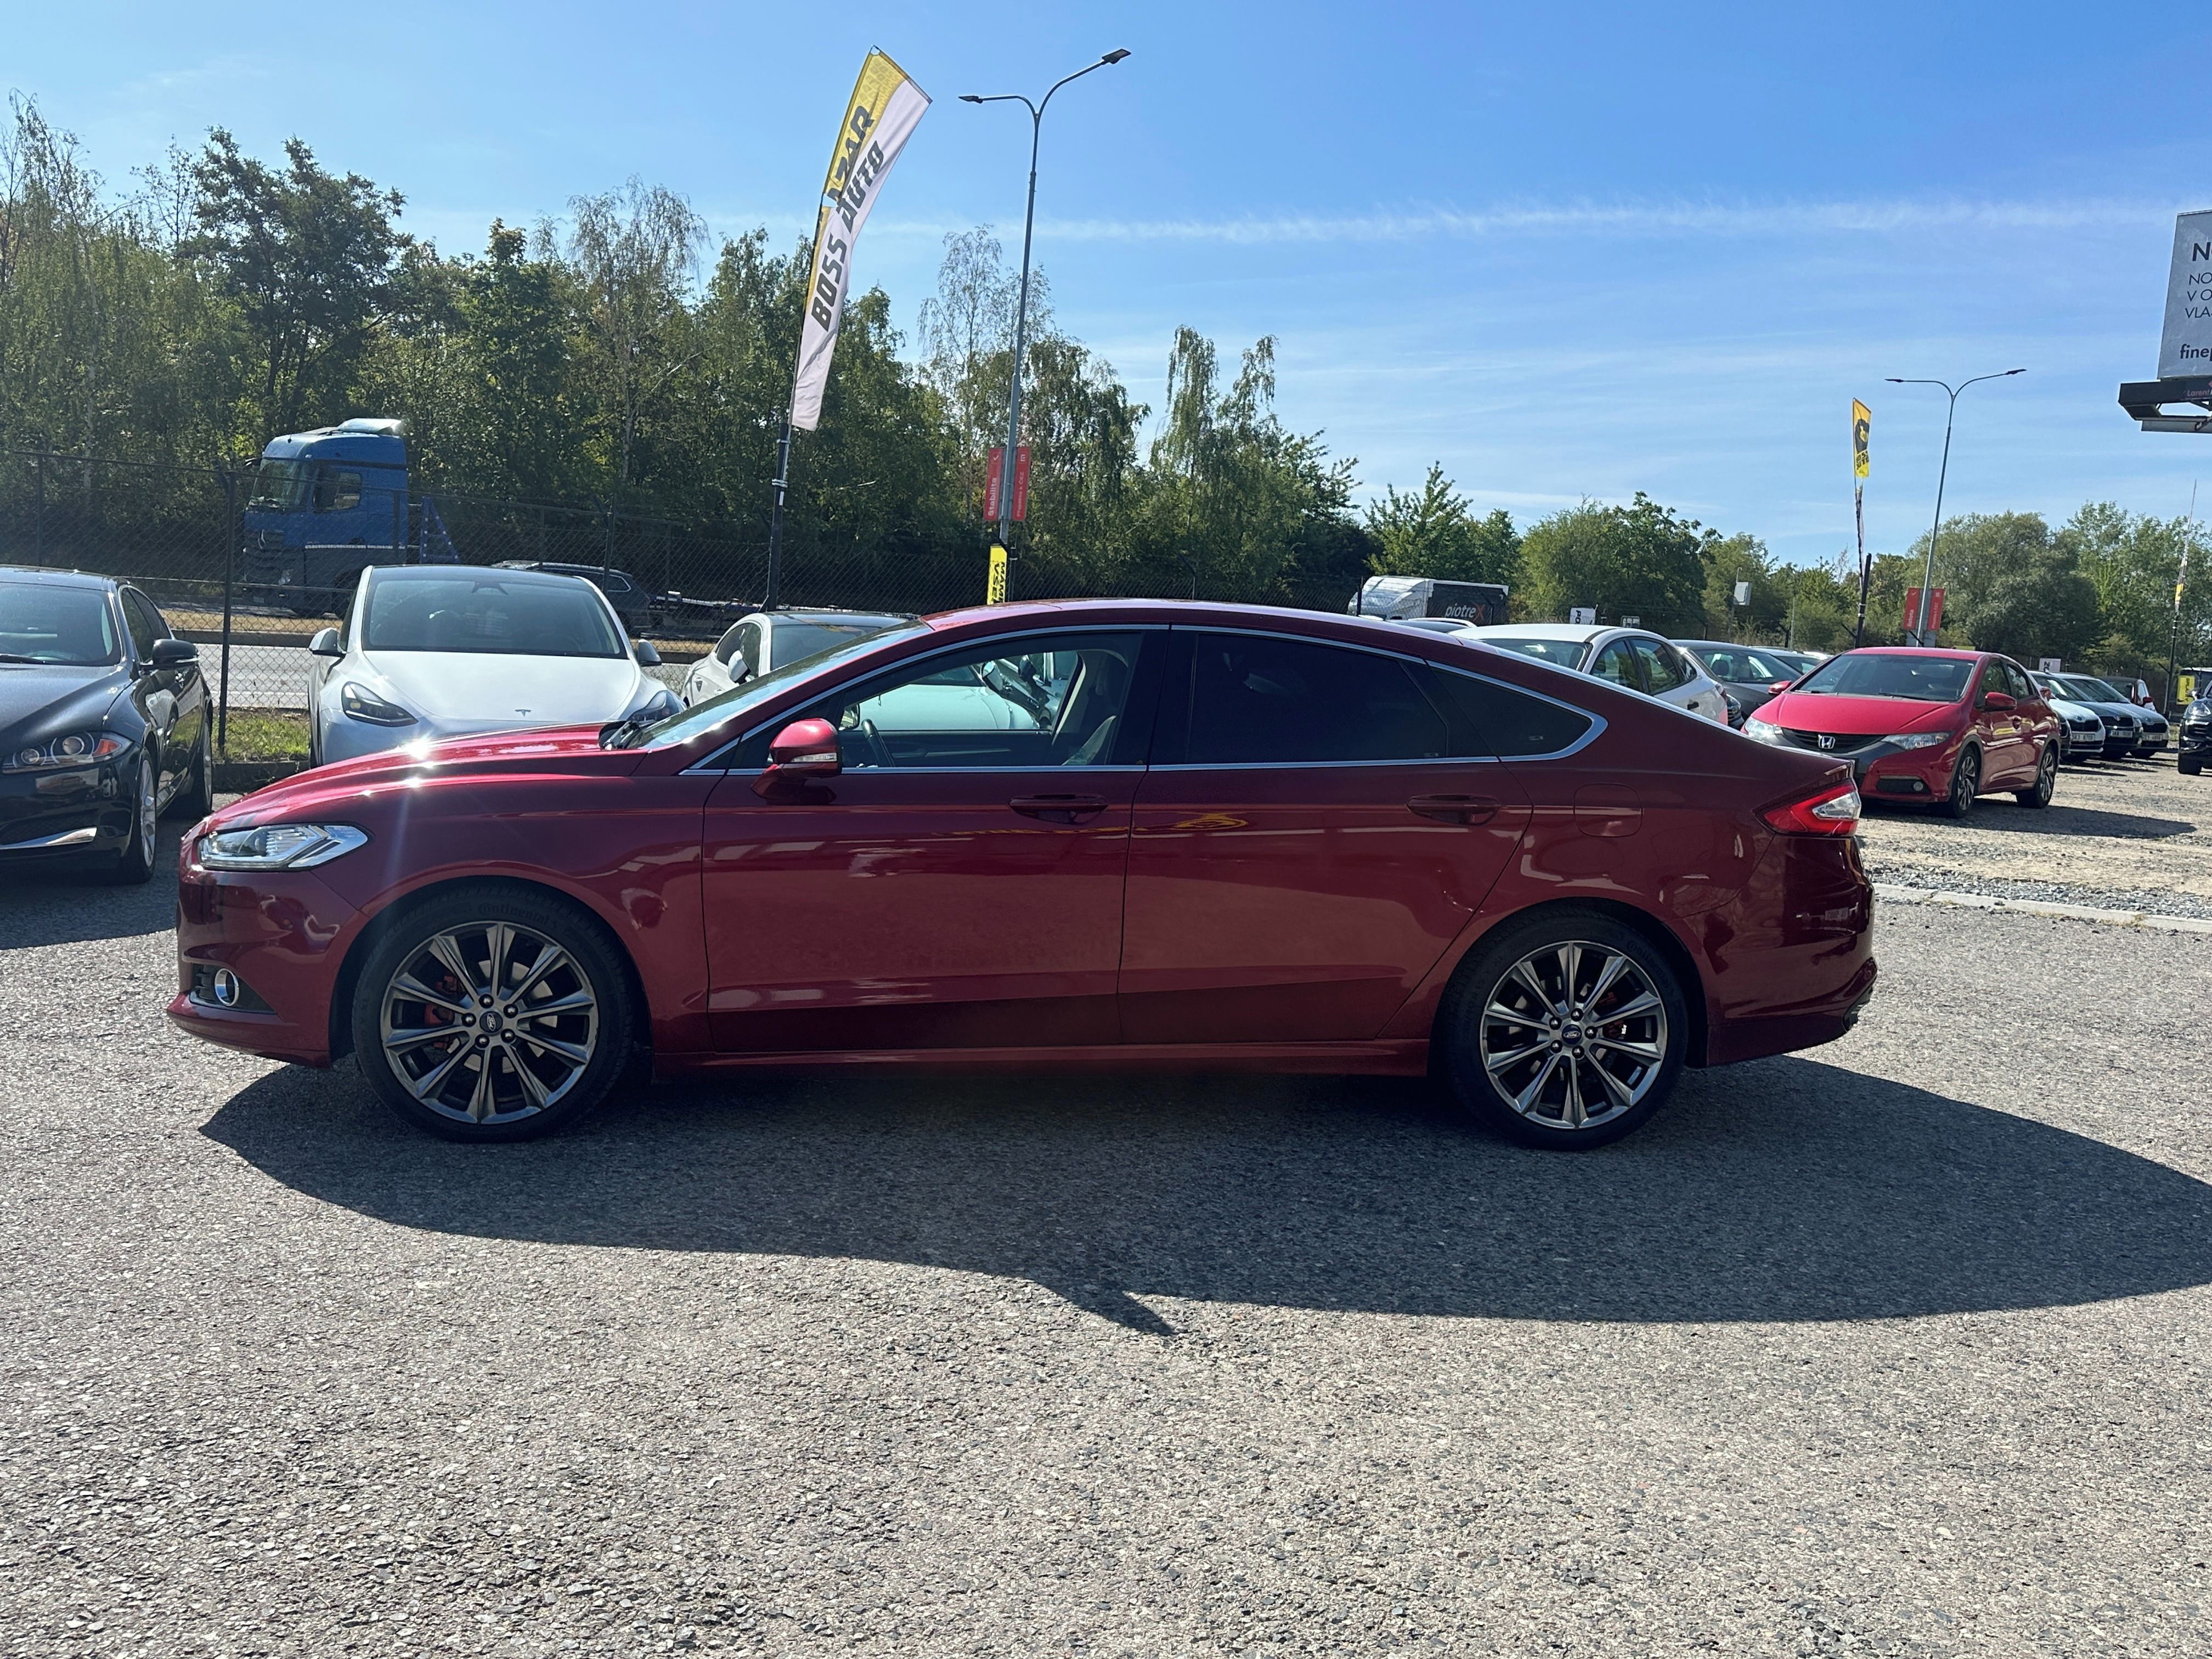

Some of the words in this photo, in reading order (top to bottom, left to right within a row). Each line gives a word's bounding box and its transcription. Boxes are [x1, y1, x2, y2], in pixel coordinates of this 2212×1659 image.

[811, 233, 847, 332] BOSS
[836, 140, 884, 234] AUTO
[2192, 242, 2212, 262] N
[2187, 290, 2197, 302] V
[2185, 306, 2212, 319] VLA
[988, 477, 997, 516] Stabilita
